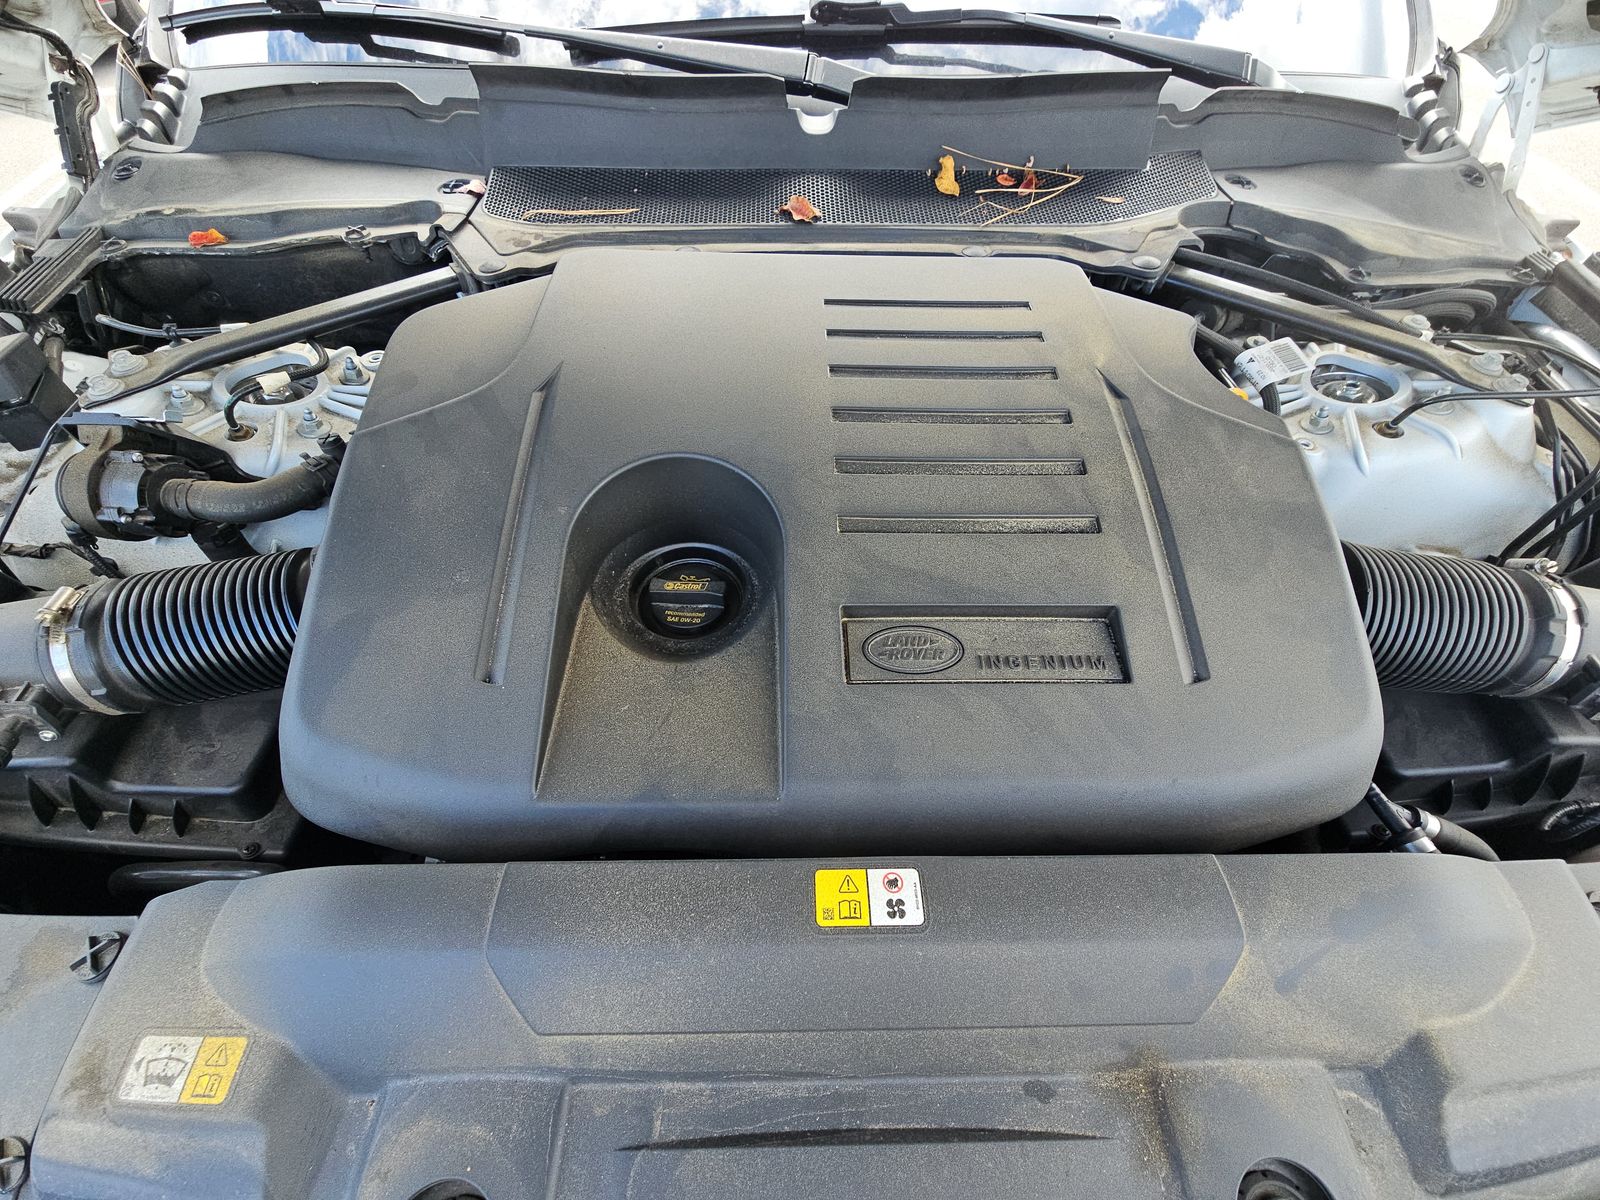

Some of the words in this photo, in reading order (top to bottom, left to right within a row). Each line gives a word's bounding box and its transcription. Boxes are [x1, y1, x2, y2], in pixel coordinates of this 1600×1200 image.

[674, 582, 702, 590] Castrol
[882, 635, 931, 649] LAND
[889, 647, 947, 661] ROVER
[976, 654, 1107, 670] INGENIUM
